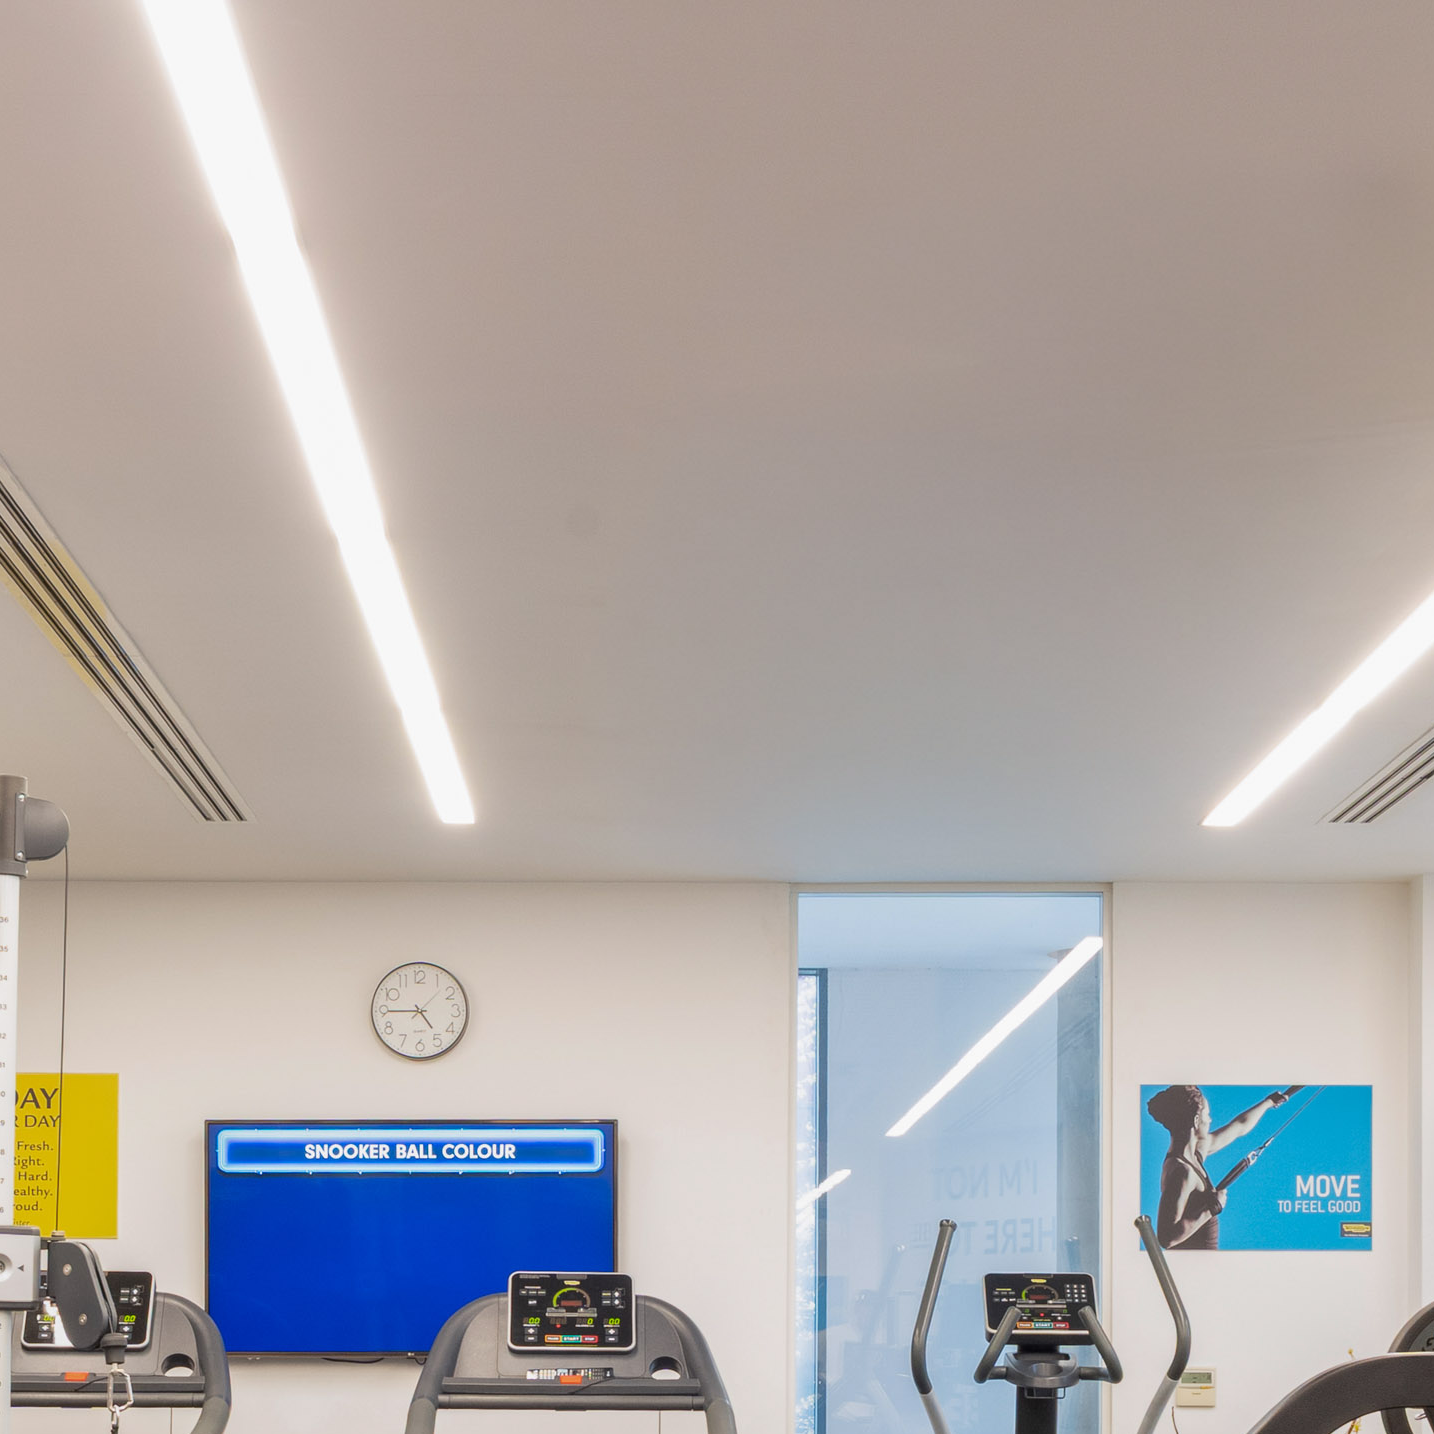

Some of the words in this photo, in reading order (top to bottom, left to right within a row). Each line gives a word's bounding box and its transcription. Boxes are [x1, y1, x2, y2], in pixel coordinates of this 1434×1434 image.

[0, 916, 9, 924] 36
[399, 974, 407, 988] 11
[414, 970, 426, 985] 12
[435, 974, 440, 988] 1
[385, 987, 400, 1001] 10
[445, 986, 456, 1001] 2
[379, 1005, 389, 1018] 9
[451, 1003, 462, 1018] 3
[384, 1021, 394, 1035] 8
[445, 1021, 456, 1035] 4
[399, 1033, 408, 1048] 7
[415, 1038, 425, 1052] 6
[432, 1033, 443, 1048] 5
[25, 1114, 60, 1128] DAY
[17, 1141, 54, 1151] Fresh.
[305, 1144, 390, 1160] SNOOKER
[396, 1144, 437, 1159] BALL
[442, 1143, 516, 1160] COLOUR
[18, 1171, 52, 1181] Hard.
[13, 1186, 53, 1200] ealthy.
[1295, 1174, 1361, 1198] MOVE
[1278, 1200, 1292, 1213] TO
[1295, 1200, 1325, 1213] FEEL
[1328, 1200, 1361, 1213] GOOD
